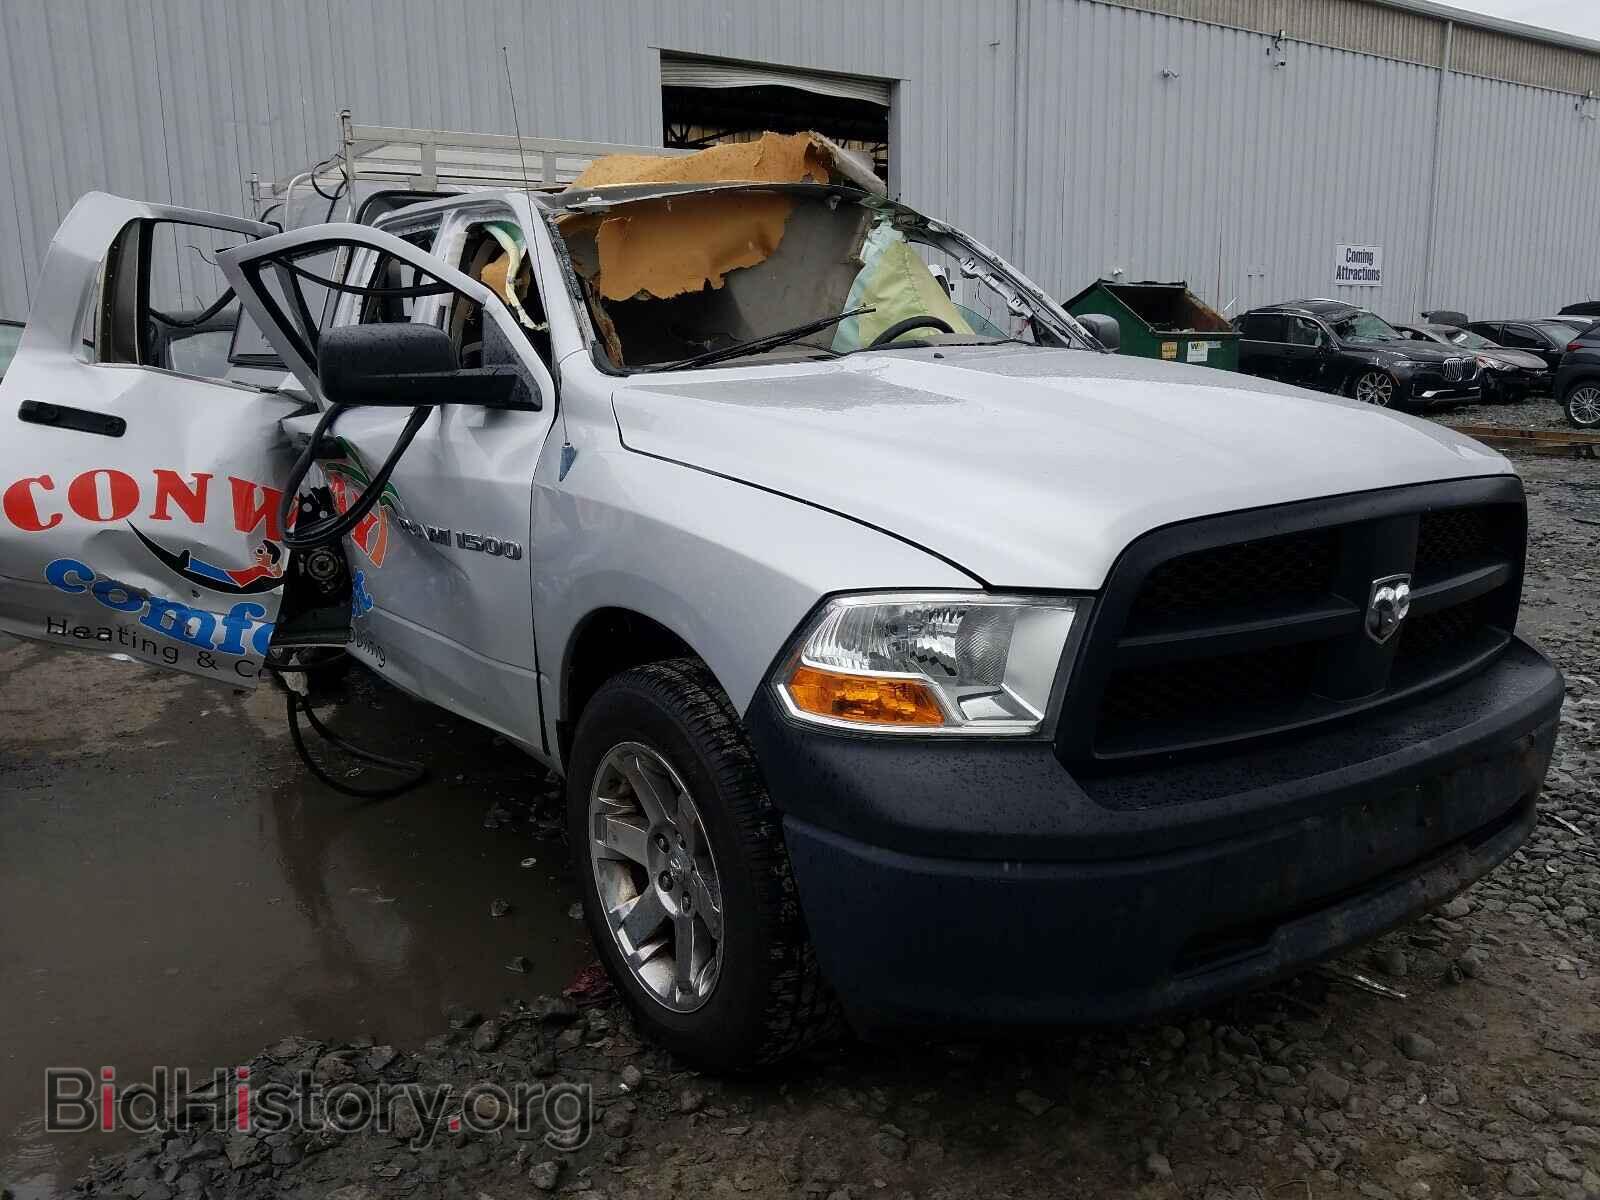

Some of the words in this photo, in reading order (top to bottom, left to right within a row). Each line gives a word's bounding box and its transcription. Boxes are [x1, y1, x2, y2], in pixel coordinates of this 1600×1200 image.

[1346, 248, 1374, 266] Coming
[1336, 265, 1381, 281] Attractions
[456, 531, 522, 561] 1500
[46, 616, 178, 665] Heating
[197, 651, 218, 671] &
